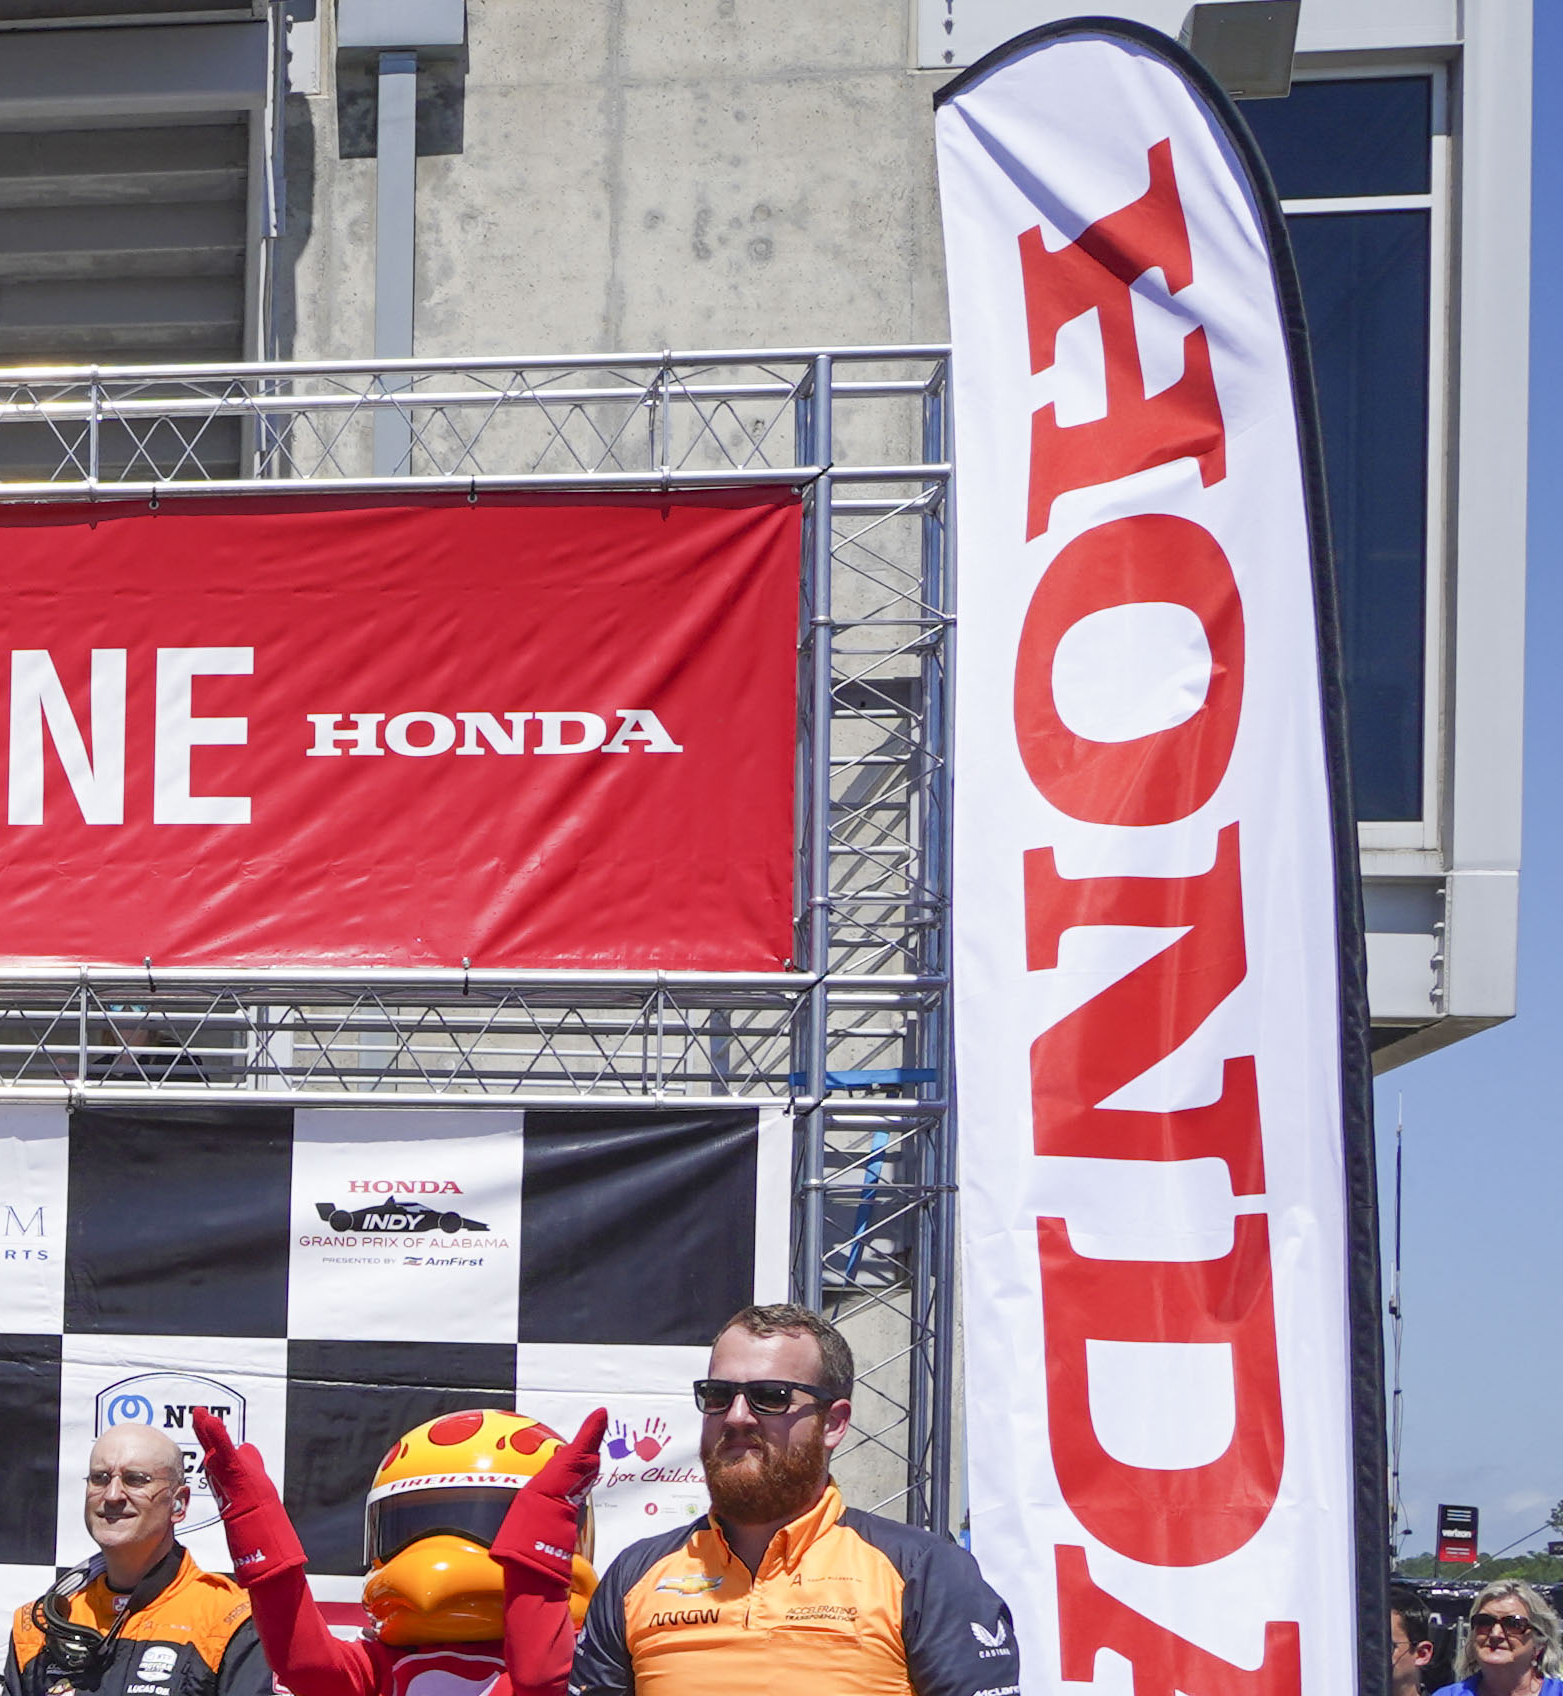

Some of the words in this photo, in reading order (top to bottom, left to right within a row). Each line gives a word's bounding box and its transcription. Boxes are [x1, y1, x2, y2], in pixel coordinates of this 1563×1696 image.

[306, 709, 683, 757] HONDA
[348, 1180, 463, 1194] HONDA
[362, 1213, 425, 1230] INDY
[299, 1236, 357, 1247] GRAND
[362, 1237, 398, 1248] PRIX
[403, 1238, 425, 1248] OF
[429, 1238, 509, 1248] ALABAMA
[322, 1257, 381, 1265] PRESENTED
[425, 1257, 484, 1267] AmFirst
[390, 1474, 520, 1493] FIREHAWK
[648, 1607, 721, 1629] ARROW
[786, 1604, 858, 1617] ACCELERATING
